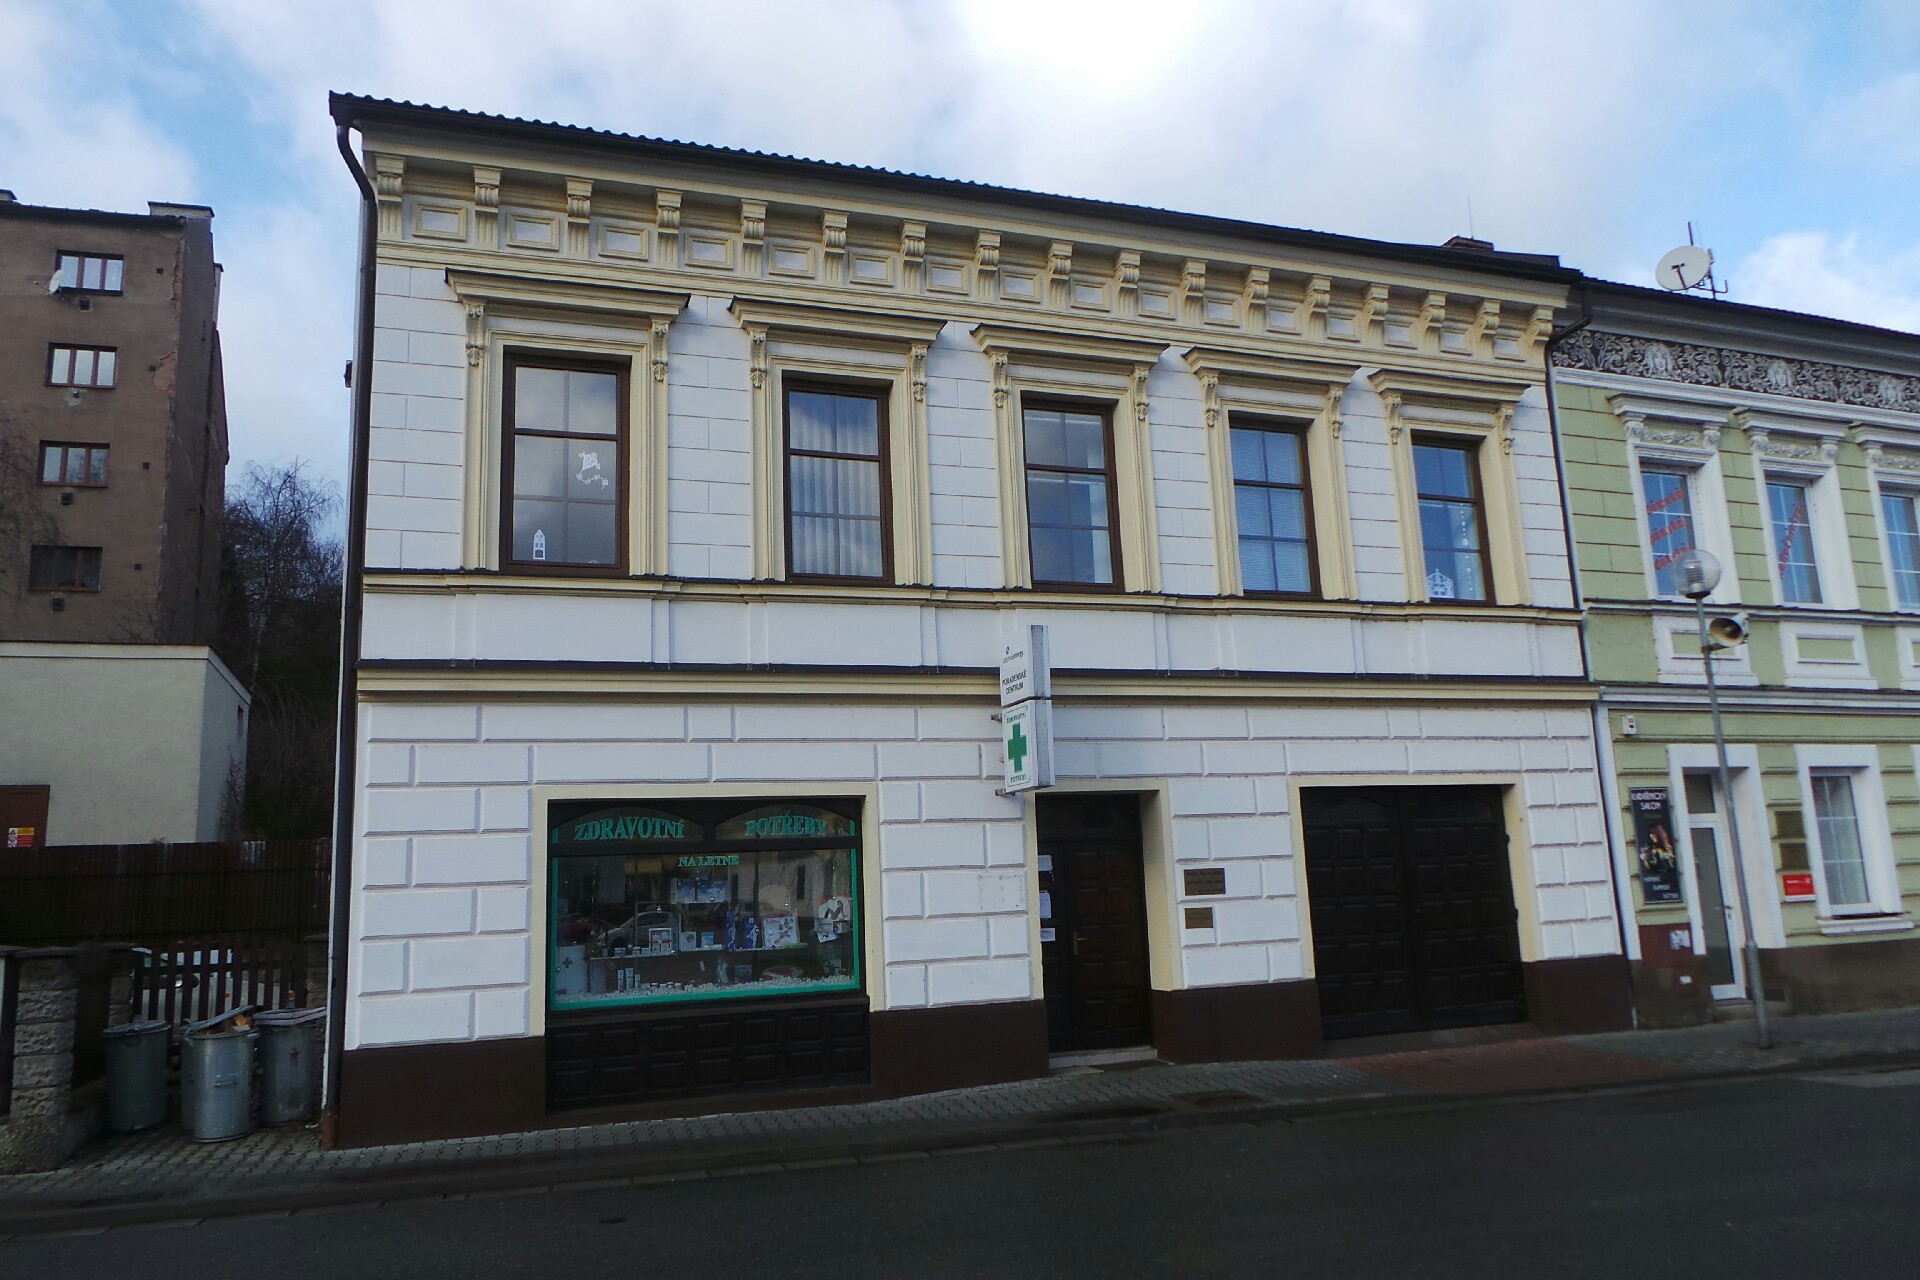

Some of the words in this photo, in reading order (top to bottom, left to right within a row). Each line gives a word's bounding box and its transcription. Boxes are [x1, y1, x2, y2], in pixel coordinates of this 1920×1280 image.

[1002, 669, 1027, 687] PORADENSKÉ
[1005, 681, 1024, 695] CENTRUM
[1640, 801, 1661, 810] SALON
[573, 816, 685, 841] ZDRAVOTNÍ
[745, 809, 828, 836] POTŘEBY
